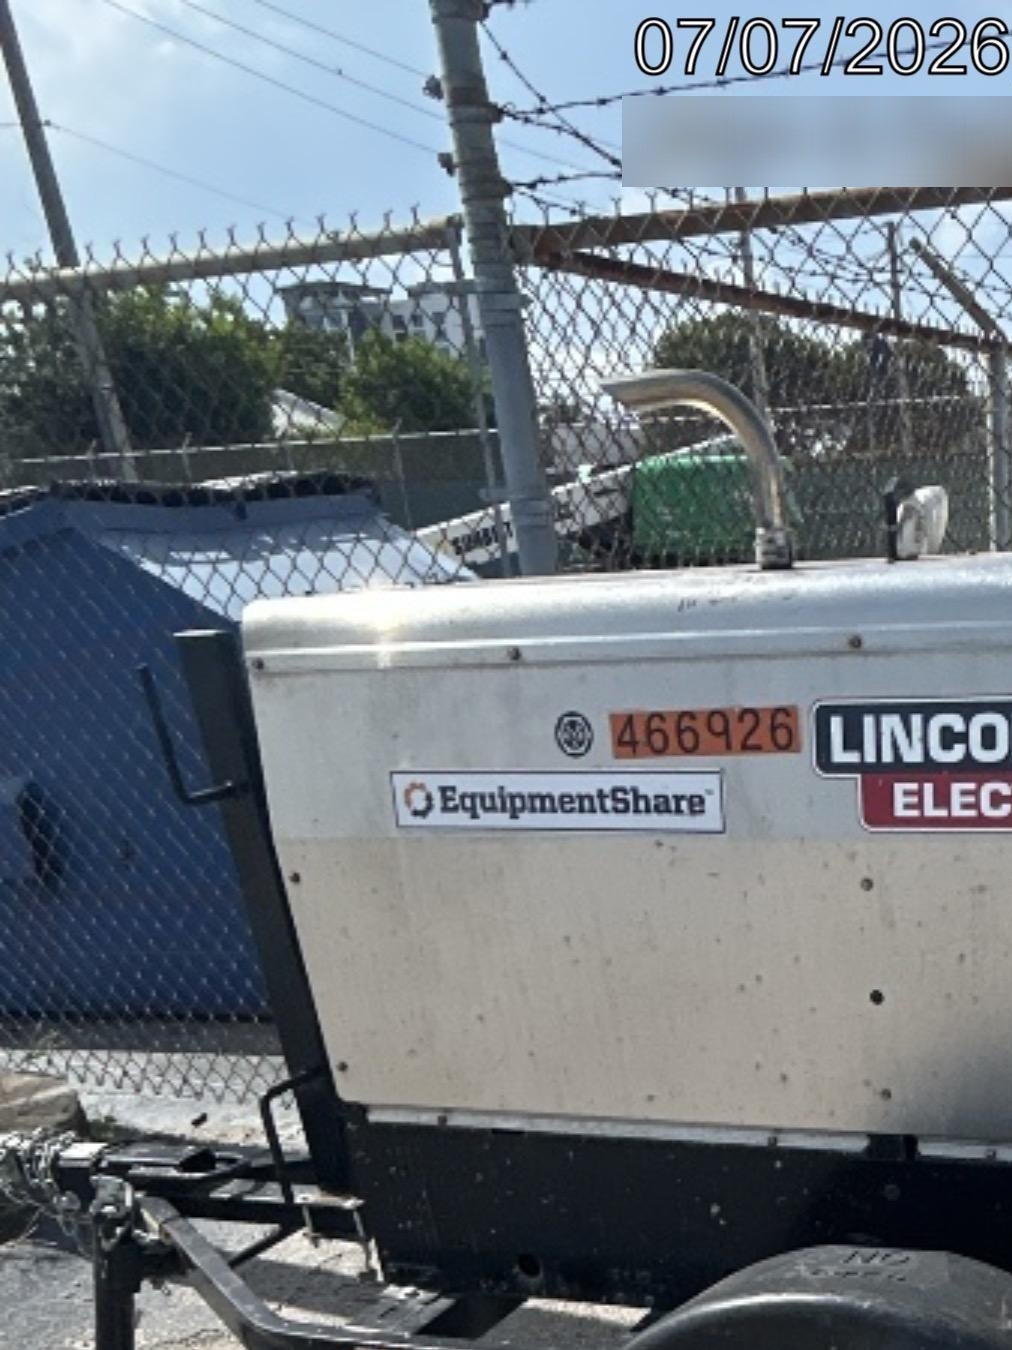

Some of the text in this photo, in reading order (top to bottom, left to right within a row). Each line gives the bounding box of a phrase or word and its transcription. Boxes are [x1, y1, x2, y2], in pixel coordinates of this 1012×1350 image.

[452, 522, 513, 556] SUNBT
[616, 707, 794, 755] 466926
[438, 785, 706, 819] EquipmentShare
